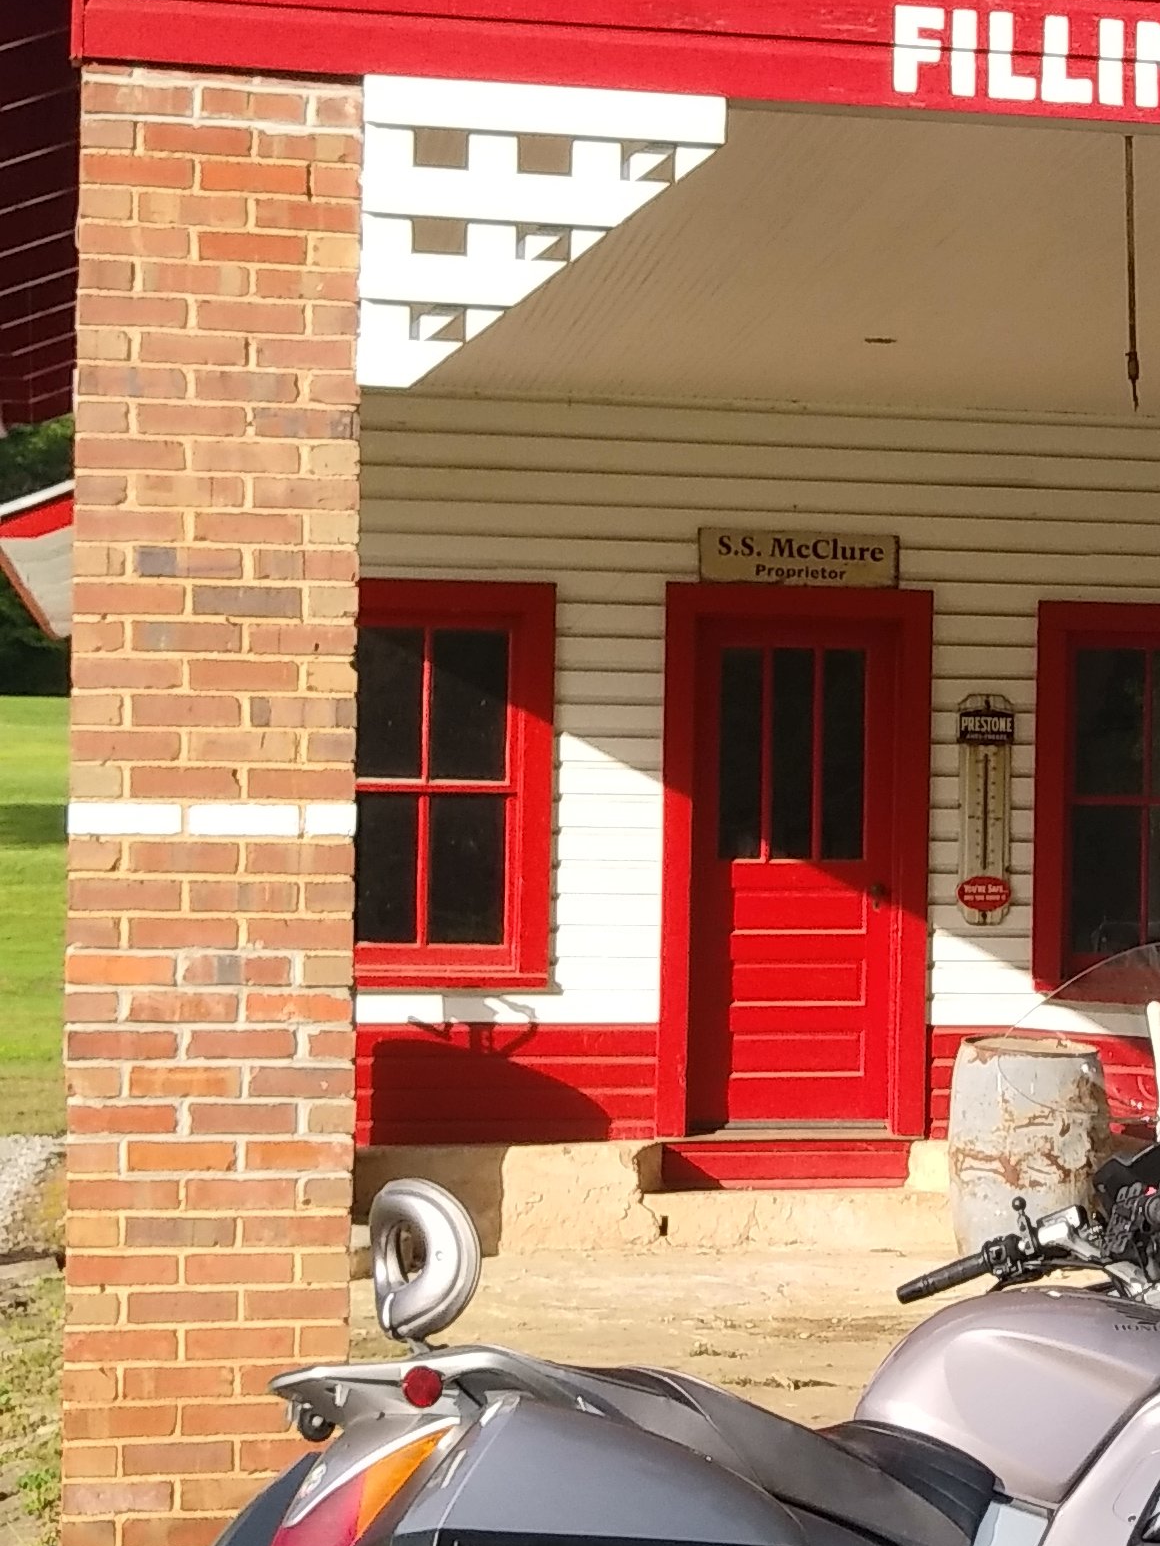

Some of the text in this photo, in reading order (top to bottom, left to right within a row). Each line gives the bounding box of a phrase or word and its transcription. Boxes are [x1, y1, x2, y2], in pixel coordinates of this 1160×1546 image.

[718, 535, 884, 562] S.S. McClure
[755, 564, 846, 580] Proprietor
[961, 716, 1013, 732] PRESTONE
